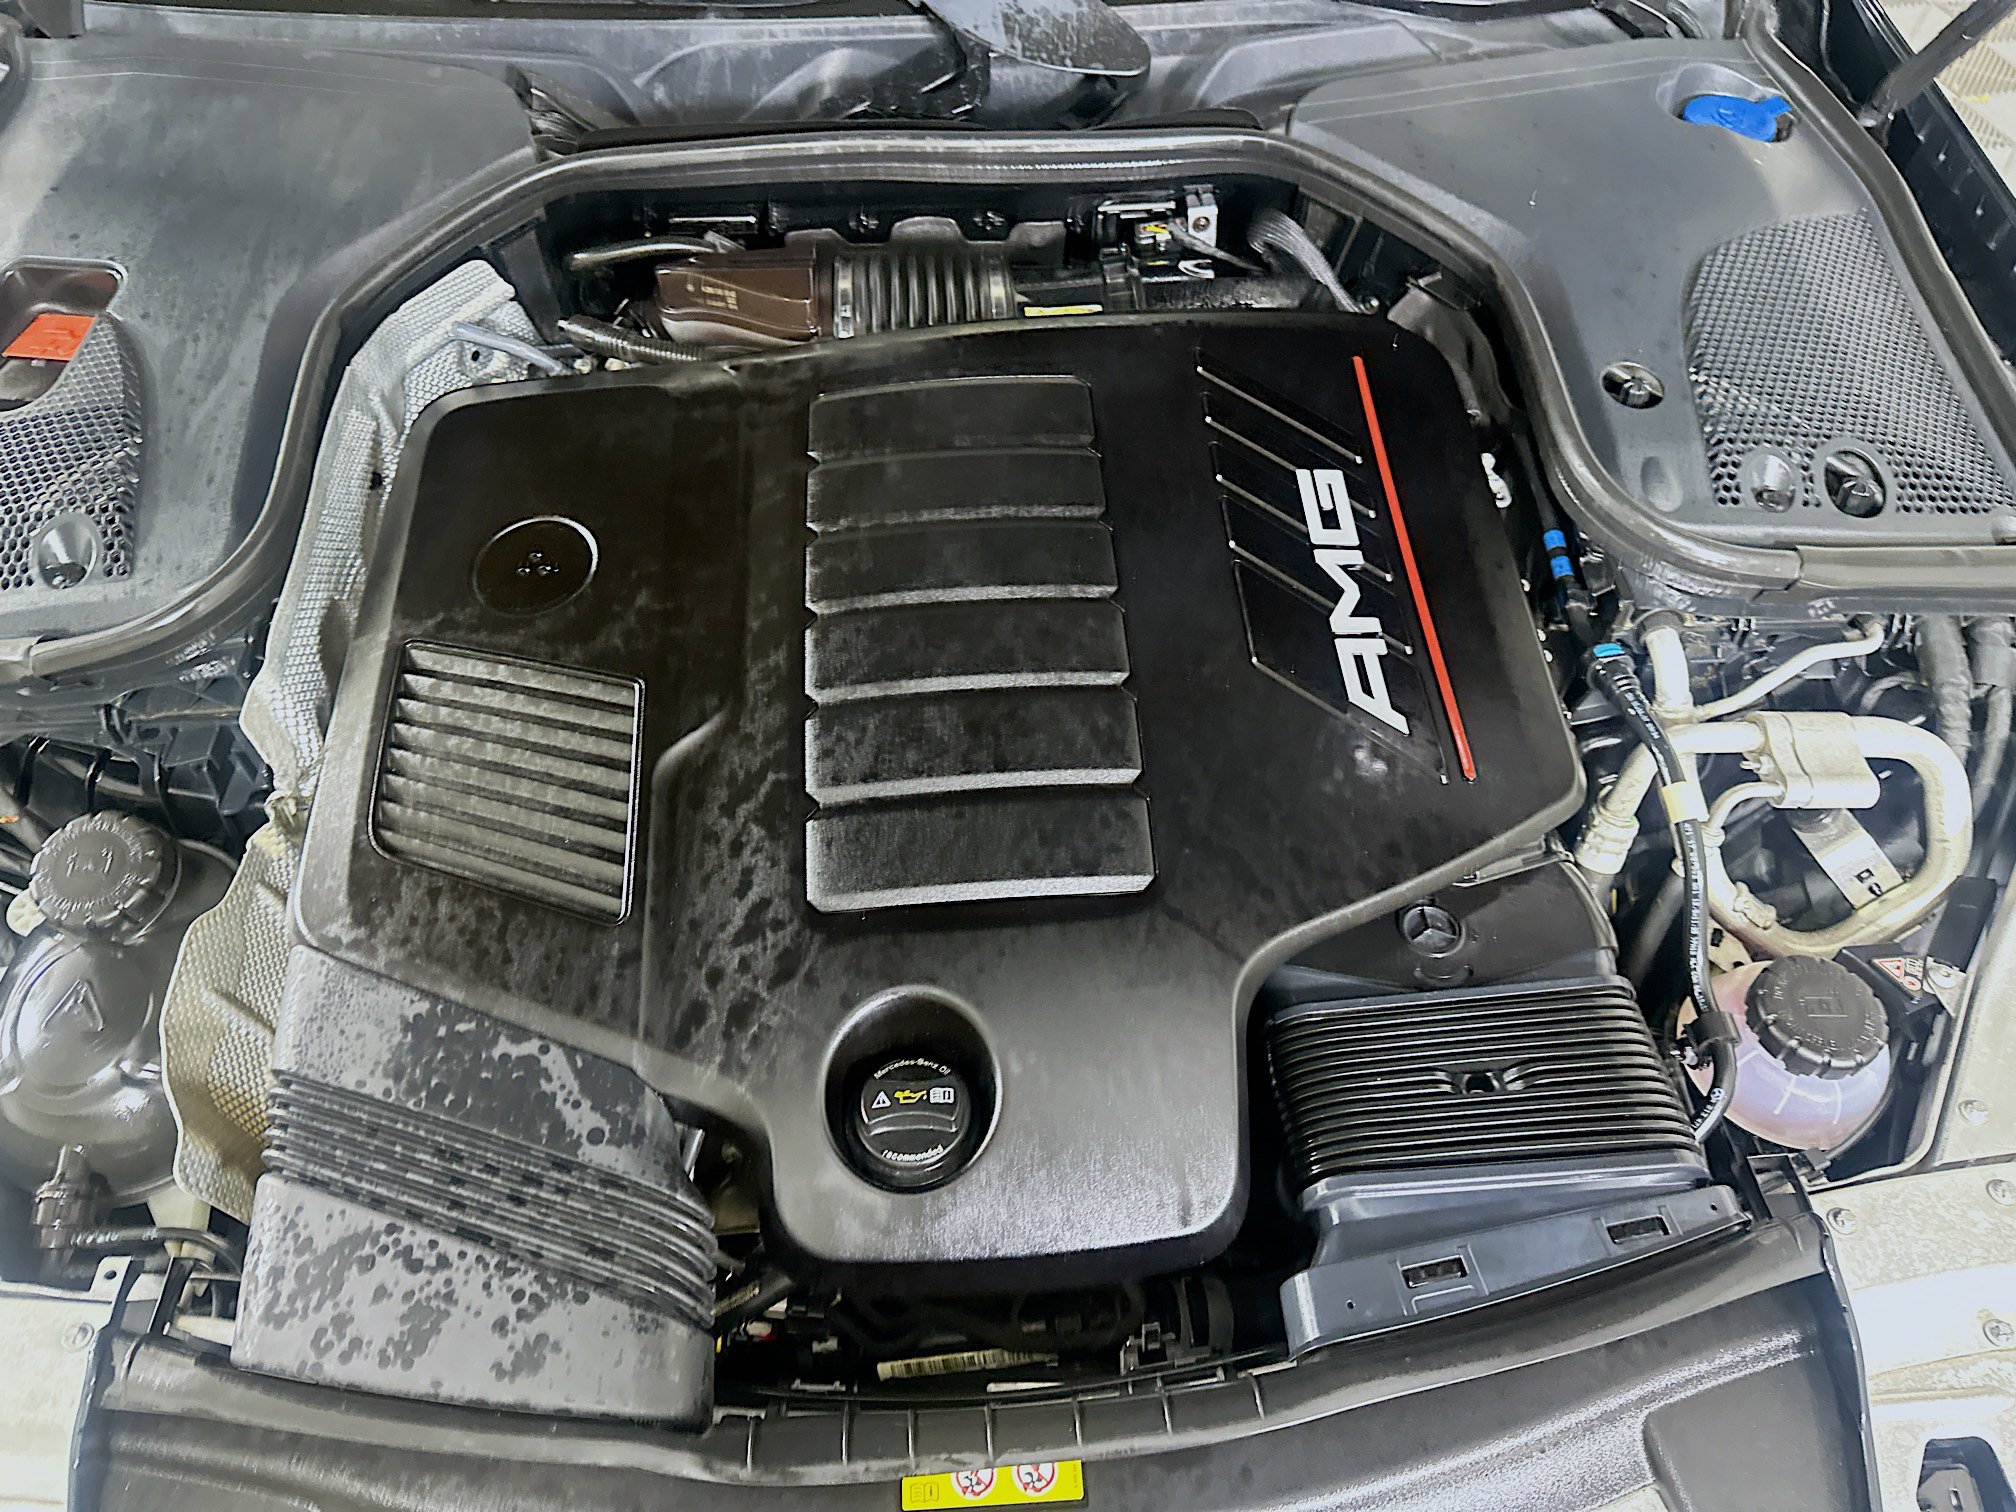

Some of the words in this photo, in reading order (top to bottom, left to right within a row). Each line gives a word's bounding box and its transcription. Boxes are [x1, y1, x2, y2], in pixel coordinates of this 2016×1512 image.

[1296, 469, 1410, 735] AMG
[874, 1058, 939, 1079] Mercedes-Benz
[938, 1065, 951, 1076] Oil
[882, 1144, 944, 1162] recommended
